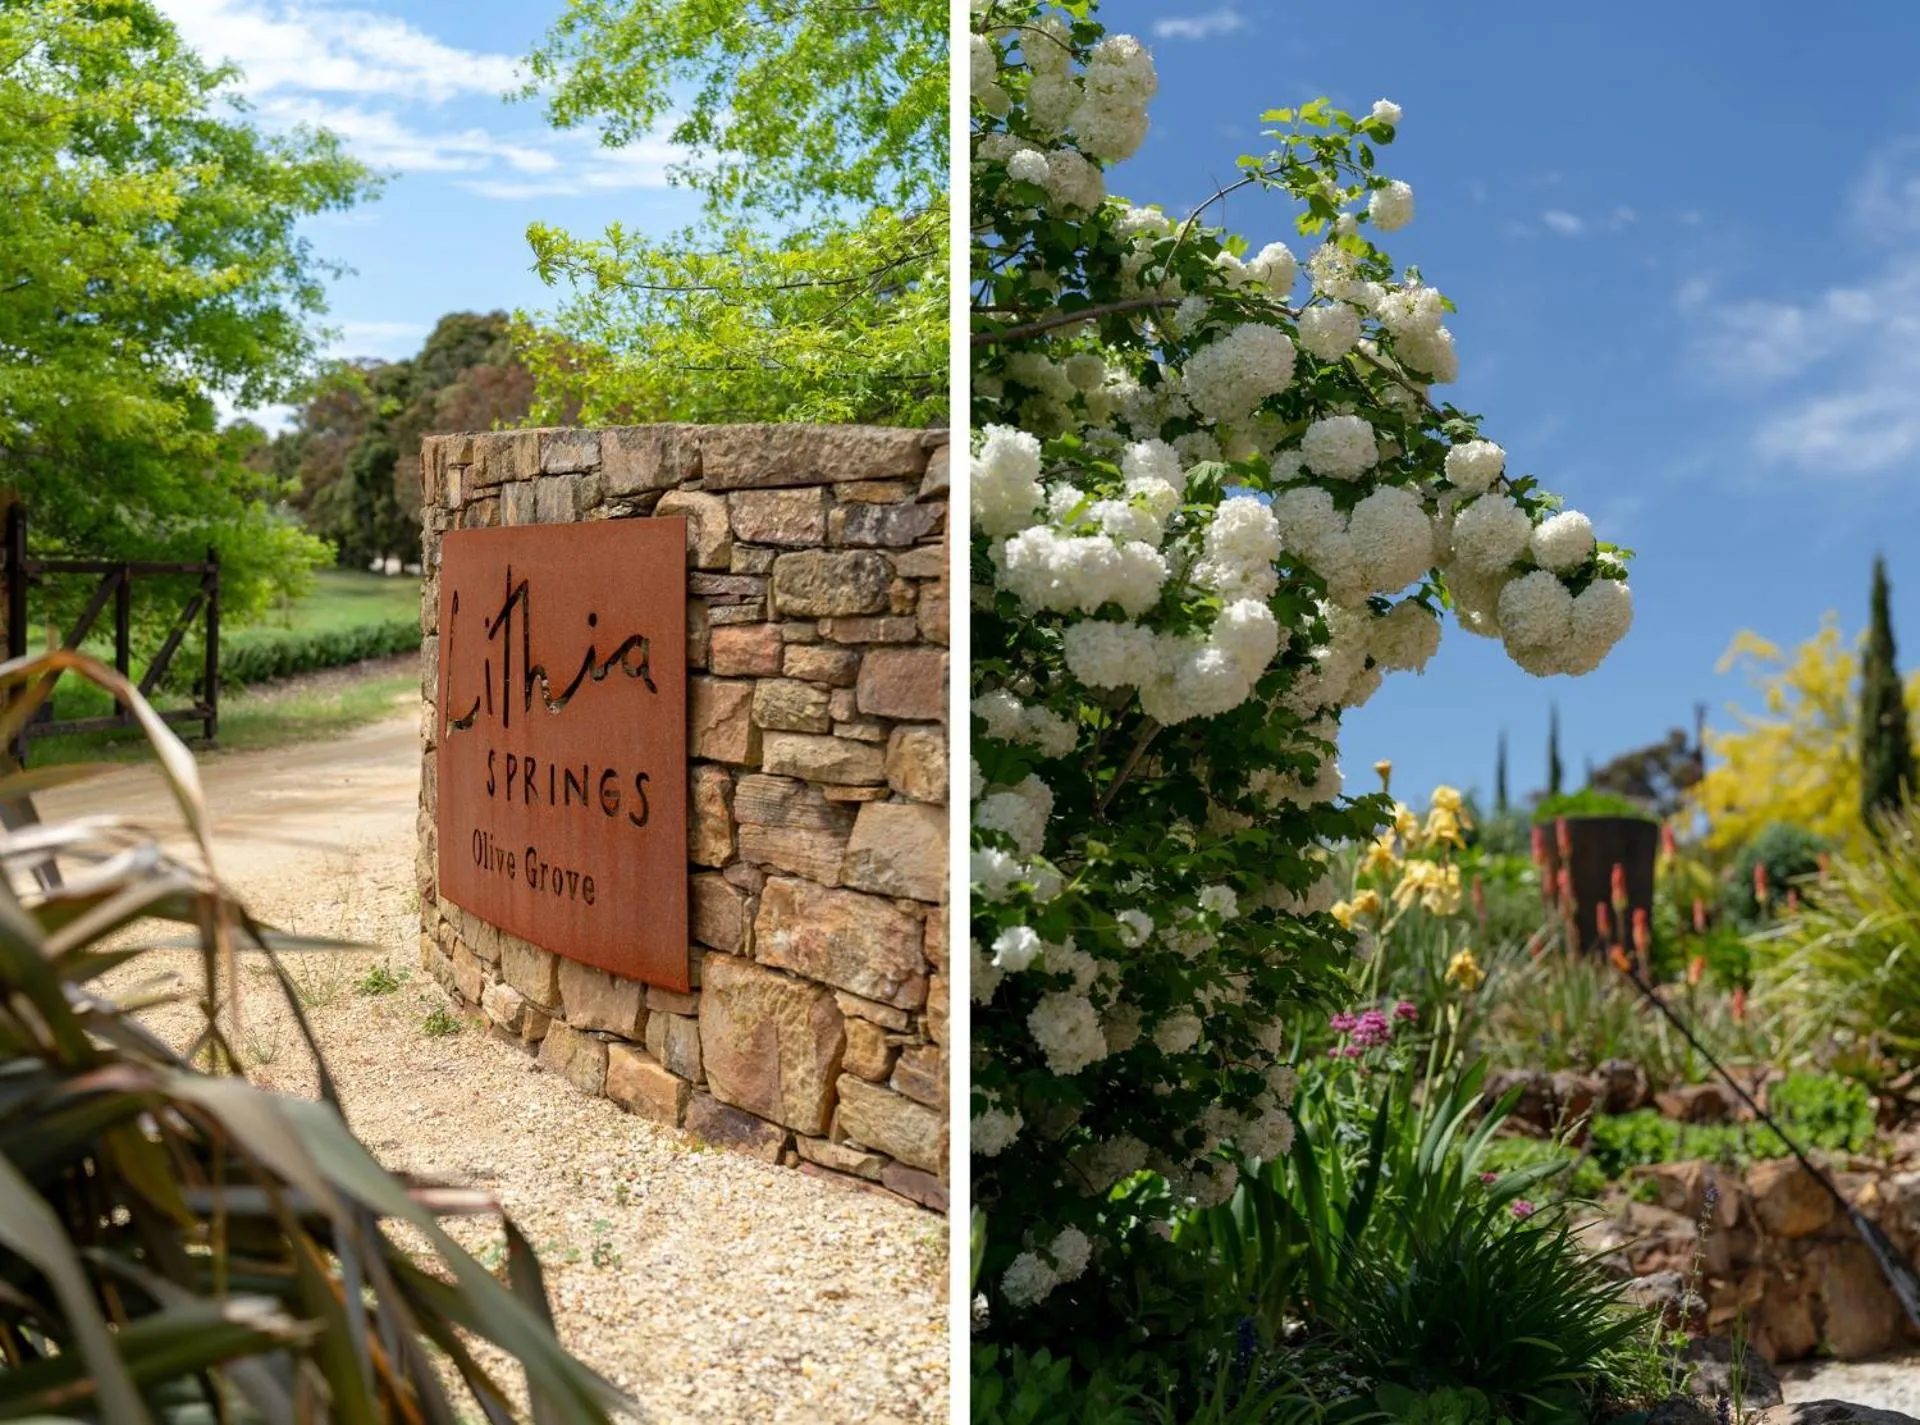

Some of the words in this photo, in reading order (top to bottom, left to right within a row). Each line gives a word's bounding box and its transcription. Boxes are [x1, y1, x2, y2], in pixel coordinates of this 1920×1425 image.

[446, 564, 658, 738] Lithia
[486, 748, 650, 827] SPRINGS
[472, 828, 515, 880] Olive
[525, 846, 595, 905] Grove
